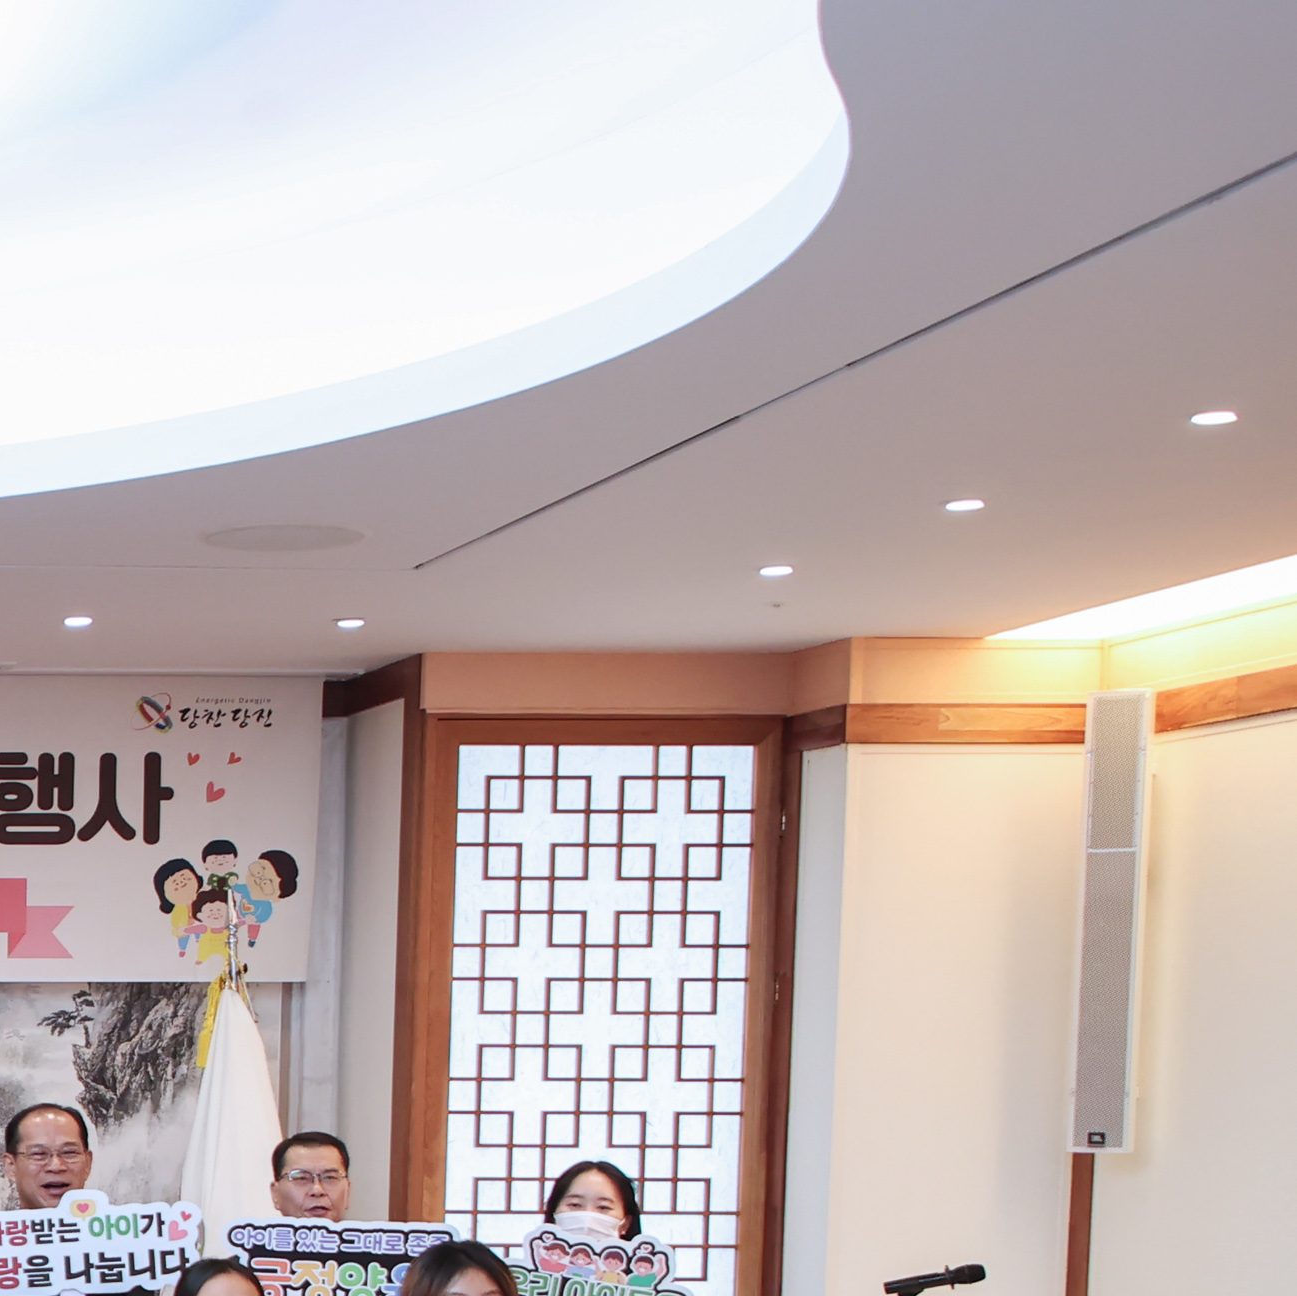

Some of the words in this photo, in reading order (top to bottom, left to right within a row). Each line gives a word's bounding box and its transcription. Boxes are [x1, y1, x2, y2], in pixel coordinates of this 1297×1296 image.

[231, 707, 273, 729] 당진
[88, 1212, 166, 1241] 아이가
[231, 1226, 294, 1250] 아이를
[296, 1227, 339, 1252] 있는
[340, 1231, 404, 1254] 그대로
[63, 1248, 189, 1285] 나눕니다
